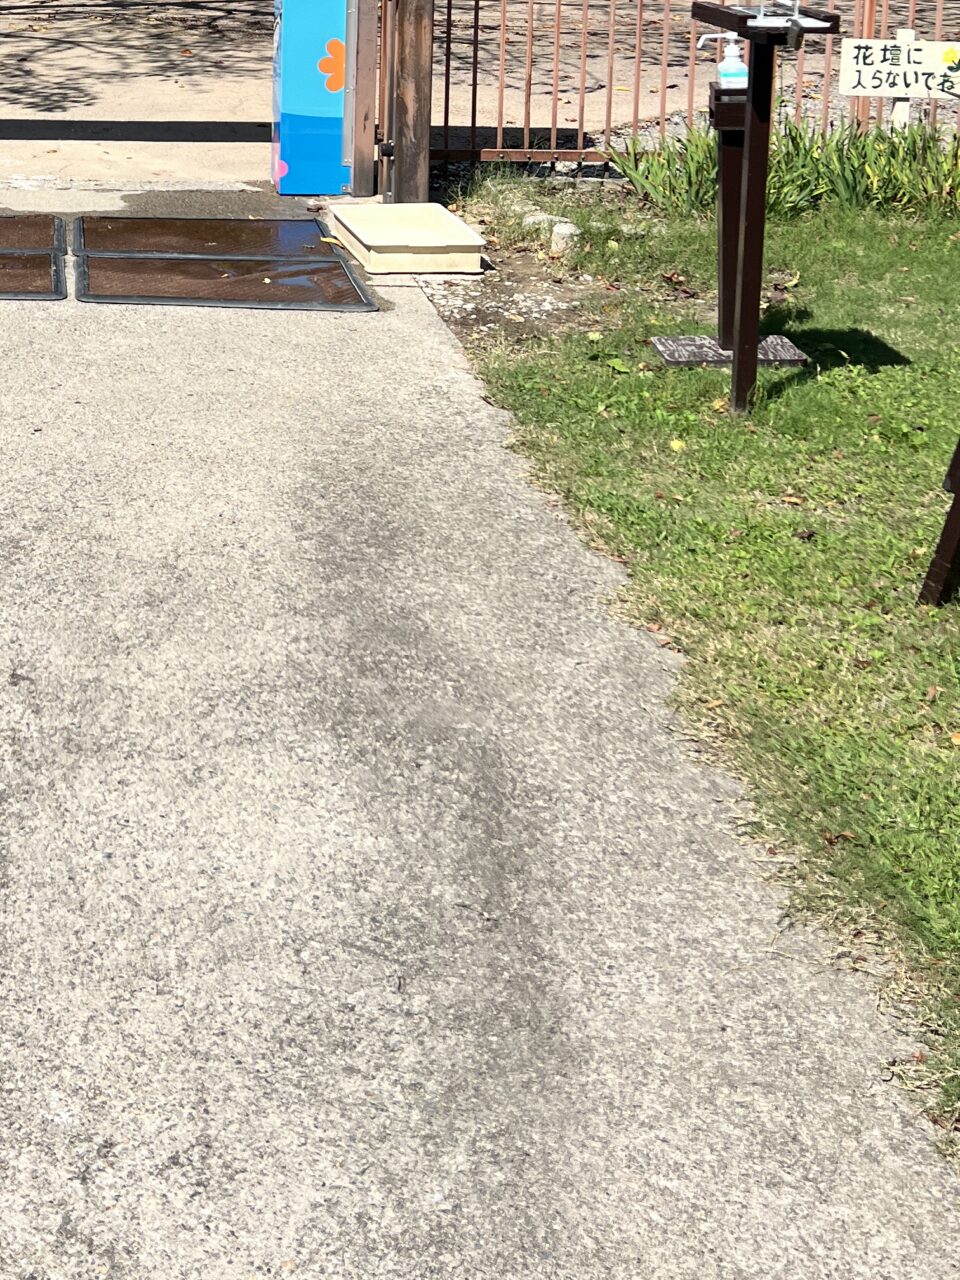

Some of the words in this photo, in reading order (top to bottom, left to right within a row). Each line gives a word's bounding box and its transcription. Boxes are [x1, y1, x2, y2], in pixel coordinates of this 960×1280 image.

[852, 44, 923, 67] 花壇に
[851, 69, 955, 93] 入らないでね
